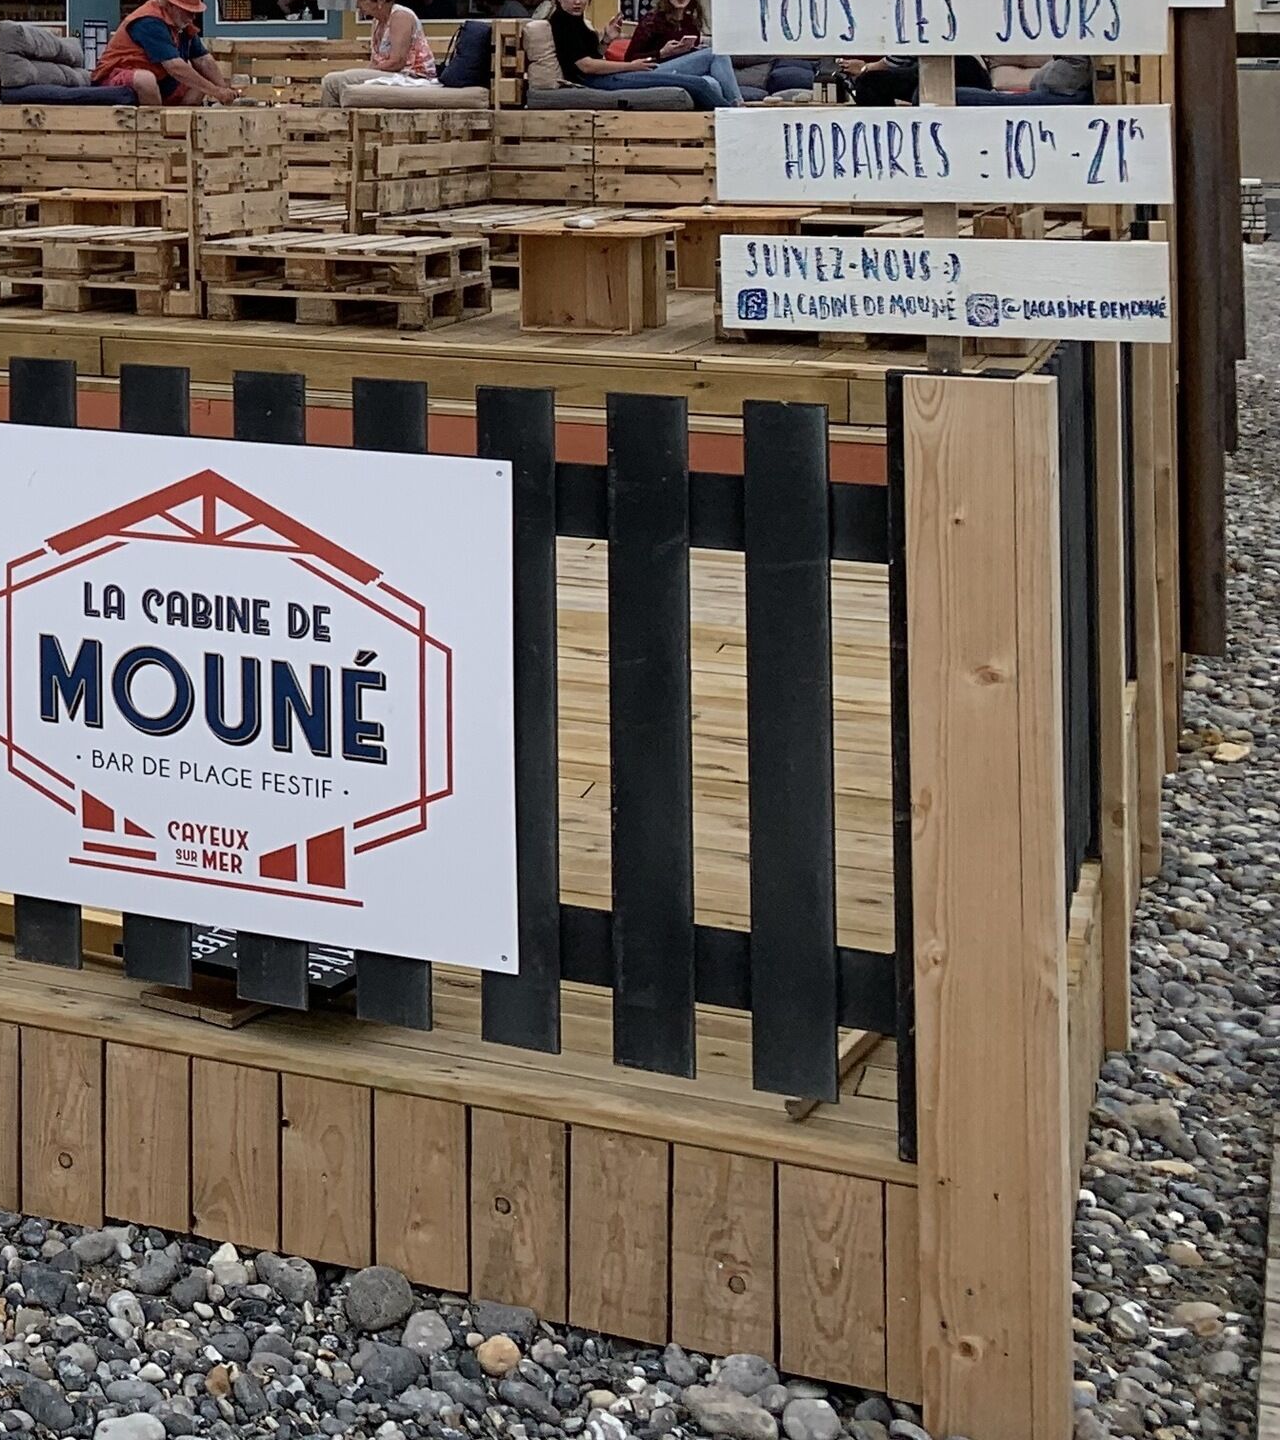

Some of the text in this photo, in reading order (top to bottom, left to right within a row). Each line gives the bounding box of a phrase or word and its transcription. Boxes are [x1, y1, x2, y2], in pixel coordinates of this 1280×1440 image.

[783, 120, 951, 180] HORAIRES
[82, 580, 331, 643] LA CABINE DE
[38, 633, 388, 766] MOUNÉ
[92, 749, 333, 800] BAR DE PLAGE FESTIF
[167, 820, 250, 852] CAYEUX
[175, 847, 244, 874] SUR MER
